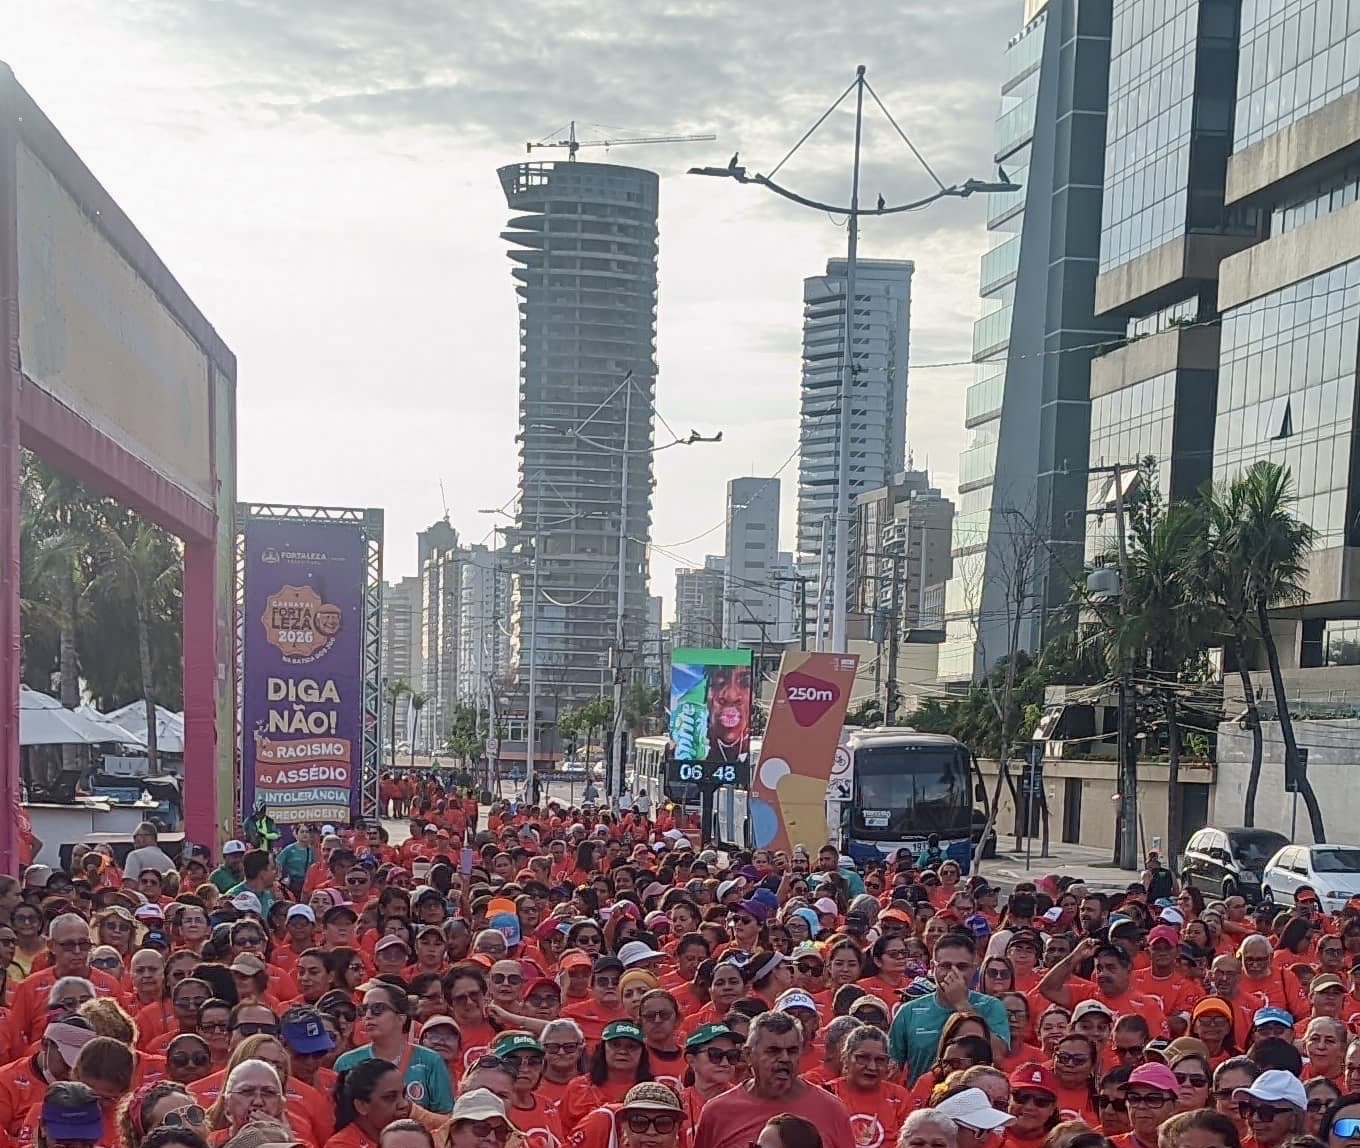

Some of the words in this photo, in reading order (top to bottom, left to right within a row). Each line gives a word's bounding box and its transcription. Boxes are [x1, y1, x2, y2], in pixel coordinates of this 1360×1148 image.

[281, 551, 327, 560] FORTALEZA
[272, 608, 312, 618] FORTA
[272, 618, 312, 630] LEZA
[278, 631, 313, 643] 2026
[267, 677, 341, 703] DIGA
[788, 687, 833, 701] 250m
[268, 703, 337, 735] NÃO!
[276, 743, 344, 759] RACISMO
[275, 764, 347, 784] ASSÉDIO
[679, 763, 703, 780] 06
[712, 765, 737, 782] 48
[265, 790, 347, 801] INTOLERÂNCIA
